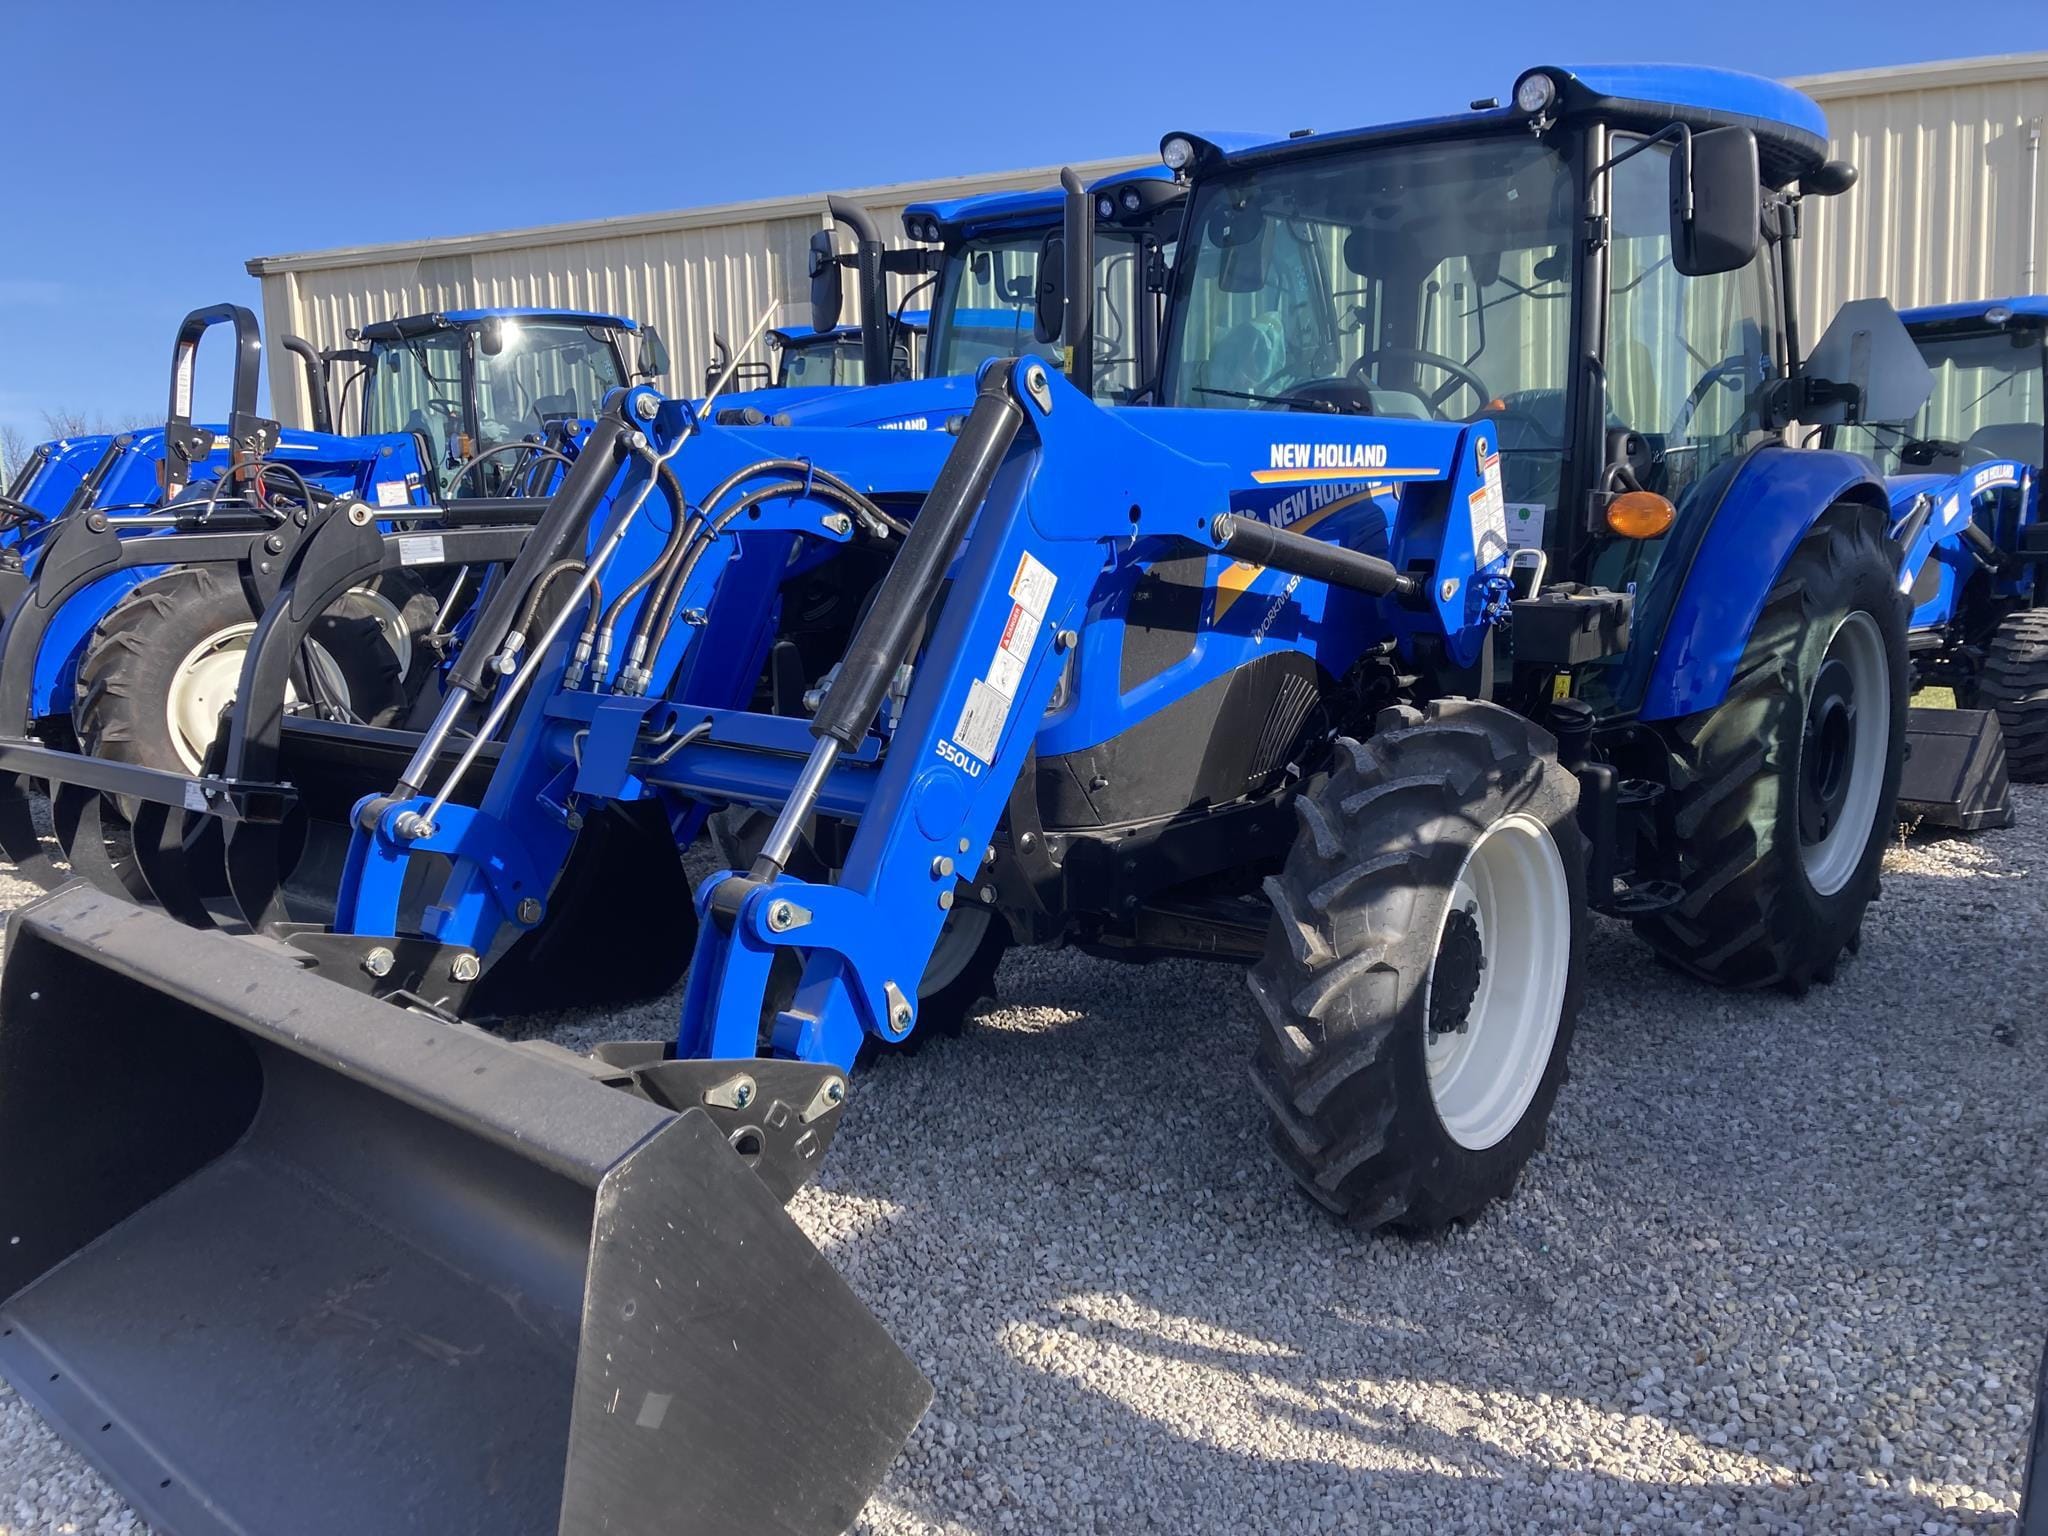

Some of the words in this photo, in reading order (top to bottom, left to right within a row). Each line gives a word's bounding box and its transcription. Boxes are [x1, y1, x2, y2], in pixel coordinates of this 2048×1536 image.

[1270, 443, 1311, 468] NEW
[1313, 443, 1387, 468] HOLLAND
[1269, 489, 1307, 528] NEW
[1007, 607, 1021, 638] DANGER
[935, 739, 982, 778] 550LU
